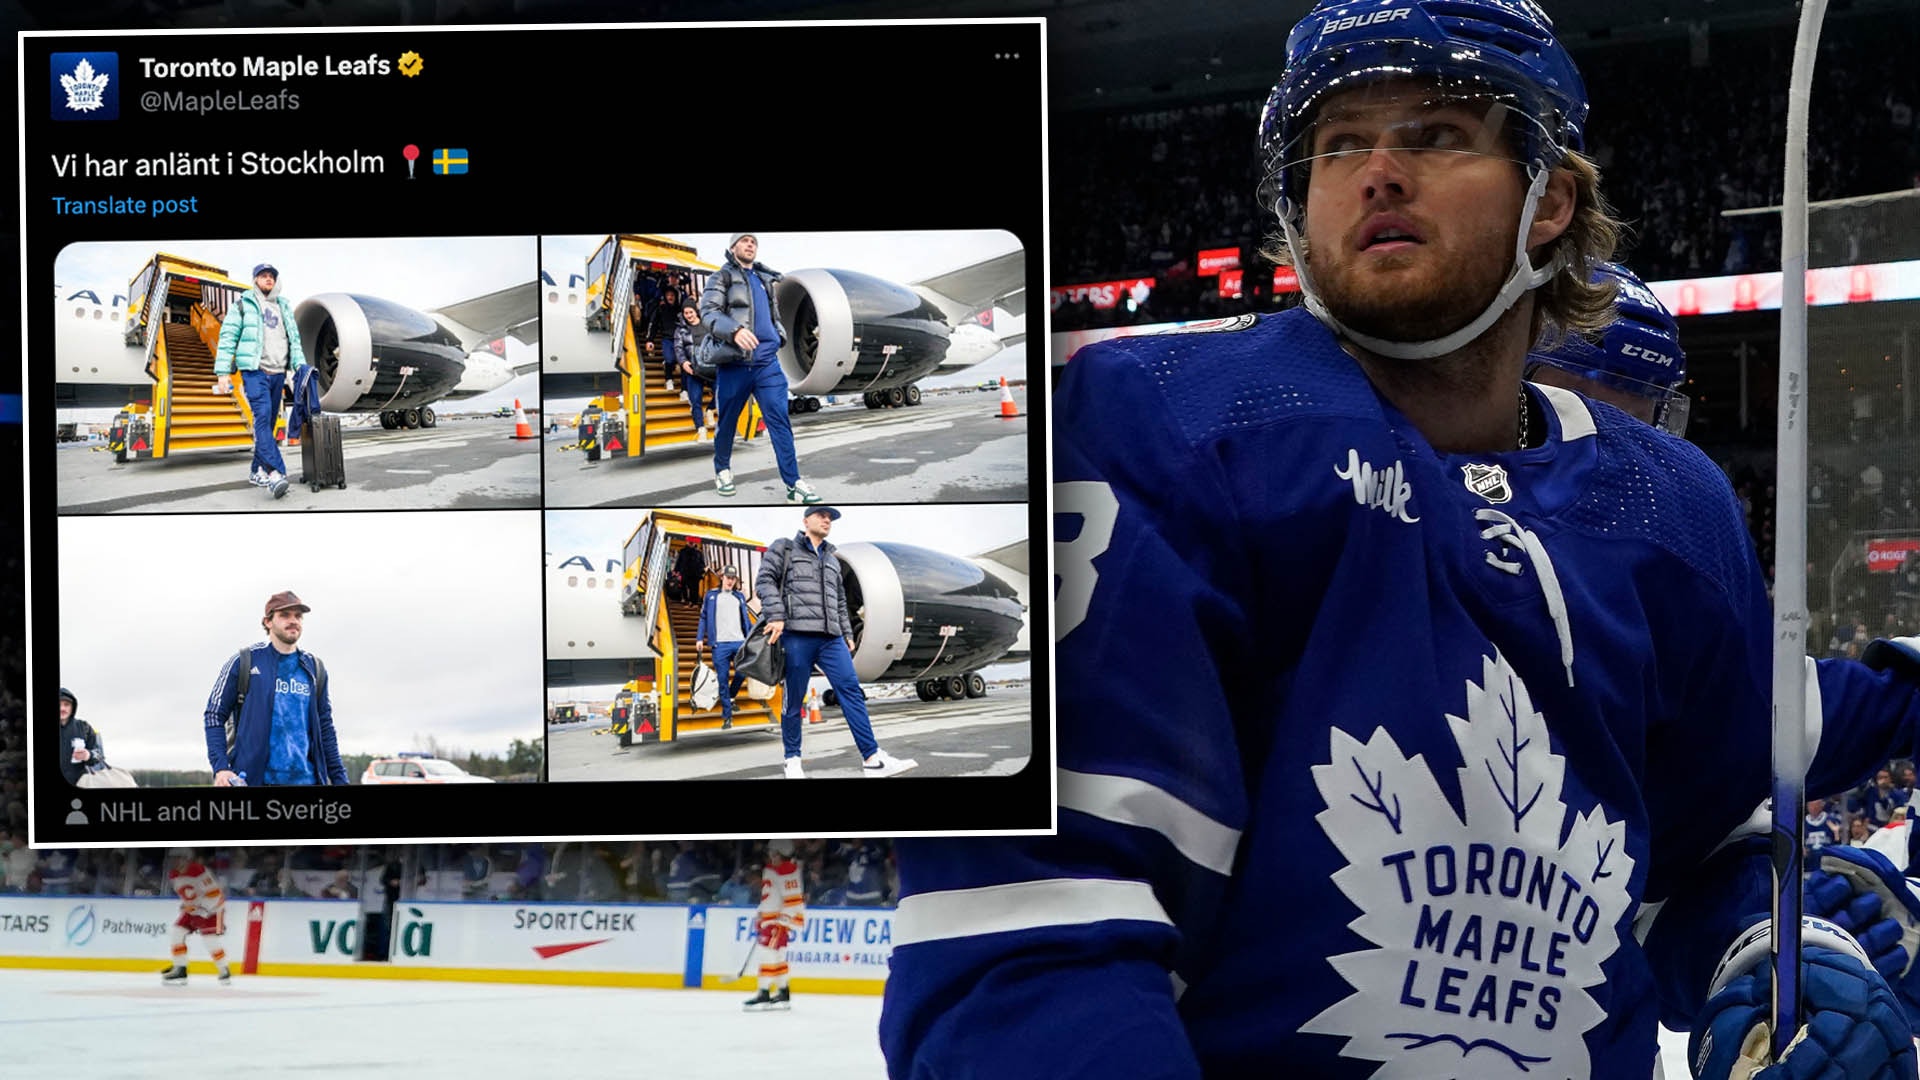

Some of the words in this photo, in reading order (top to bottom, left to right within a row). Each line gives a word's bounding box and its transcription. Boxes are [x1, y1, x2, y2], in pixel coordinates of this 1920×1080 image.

[1320, 7, 1412, 36] BAUER
[1620, 343, 1674, 368] CCM
[1333, 448, 1421, 524] Milk
[1475, 474, 1501, 493] NHL
[1382, 842, 1600, 945] TORONTO
[101, 918, 168, 937] Pathways
[1413, 904, 1571, 978] MAPLE
[853, 952, 889, 966] FALL
[1400, 959, 1562, 1031] LEAFS
